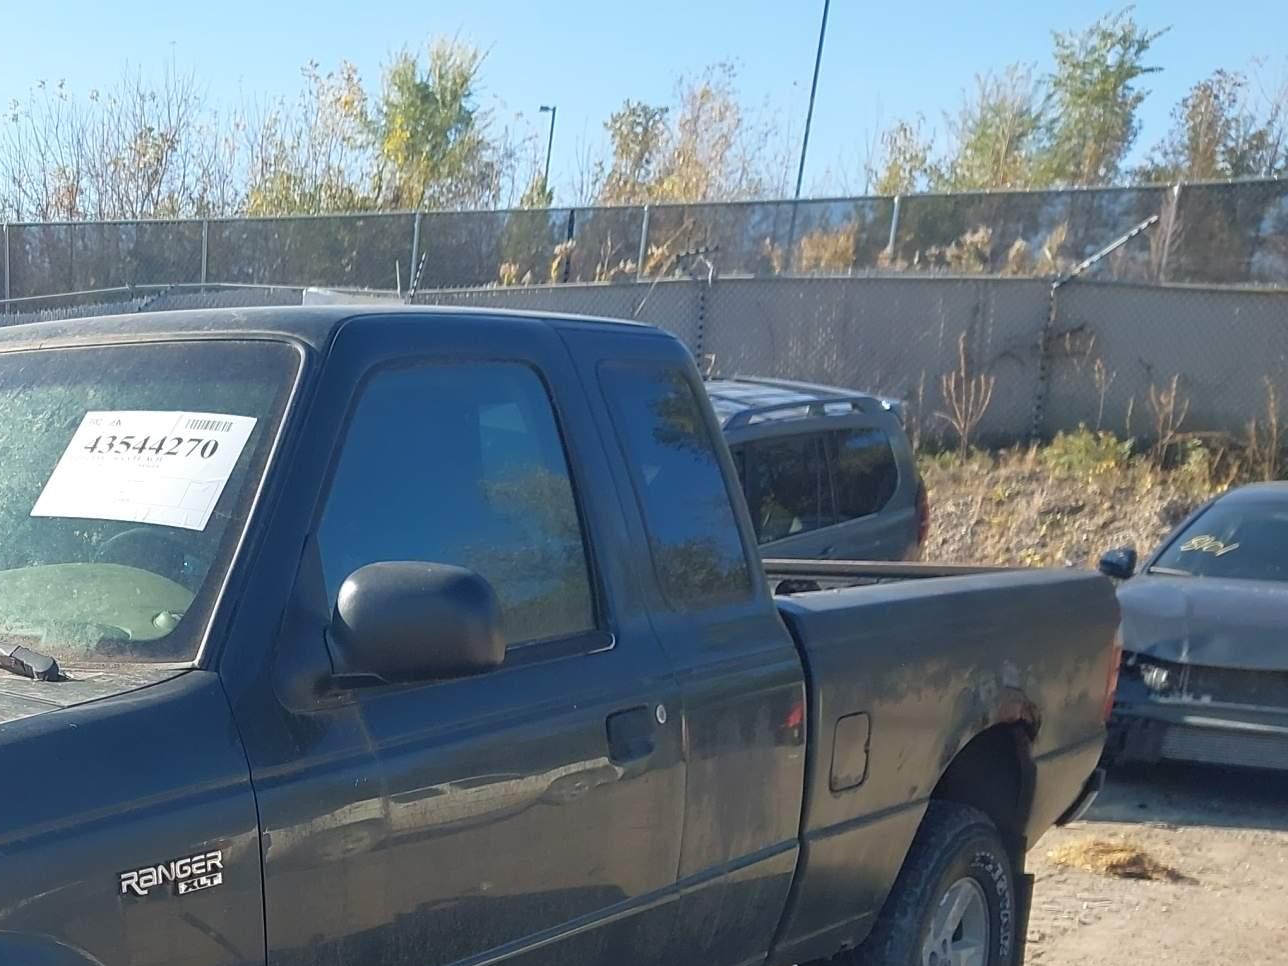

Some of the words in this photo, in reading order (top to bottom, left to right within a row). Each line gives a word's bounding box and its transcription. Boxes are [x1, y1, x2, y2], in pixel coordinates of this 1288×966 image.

[84, 435, 219, 459] 43544270
[120, 849, 224, 896] RANGER
[181, 873, 220, 893] XLT
